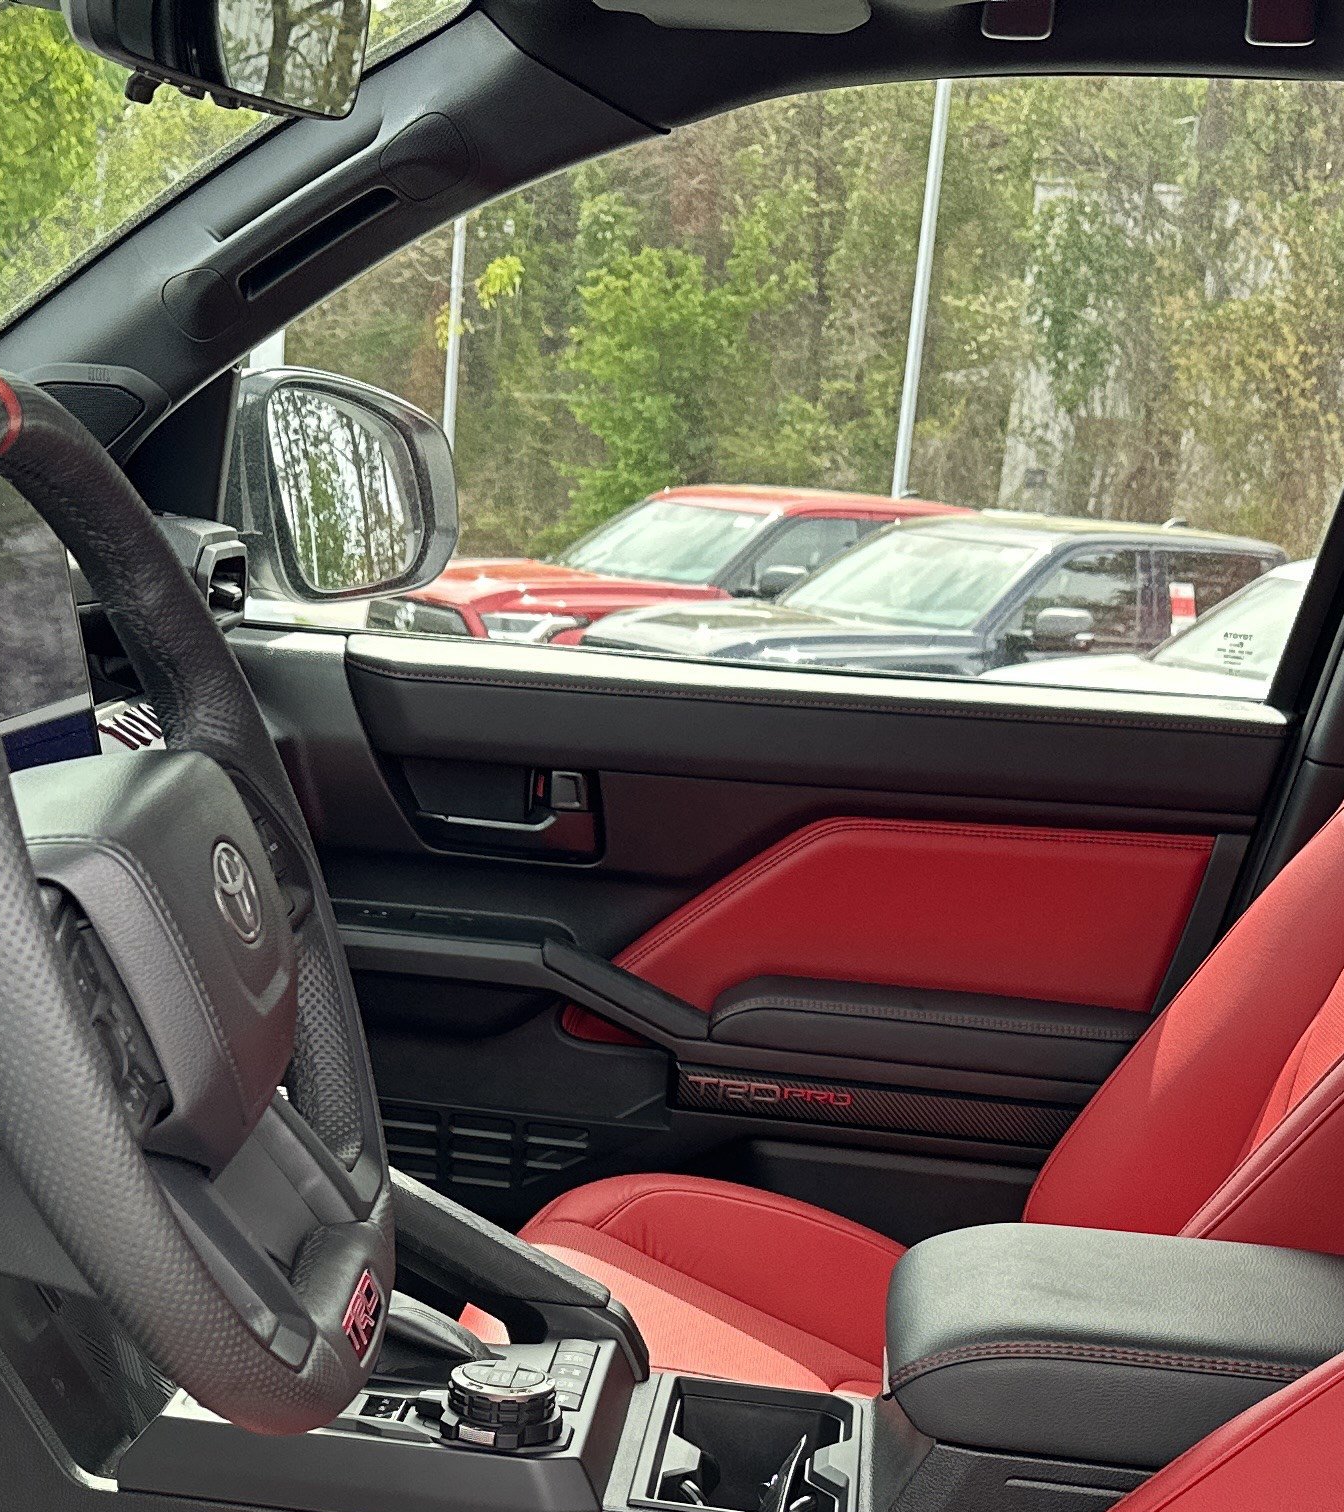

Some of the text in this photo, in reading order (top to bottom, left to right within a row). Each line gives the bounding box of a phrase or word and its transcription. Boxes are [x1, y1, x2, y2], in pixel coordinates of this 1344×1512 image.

[687, 1075, 854, 1108] TRD PRO
[341, 1269, 379, 1351] TRD
